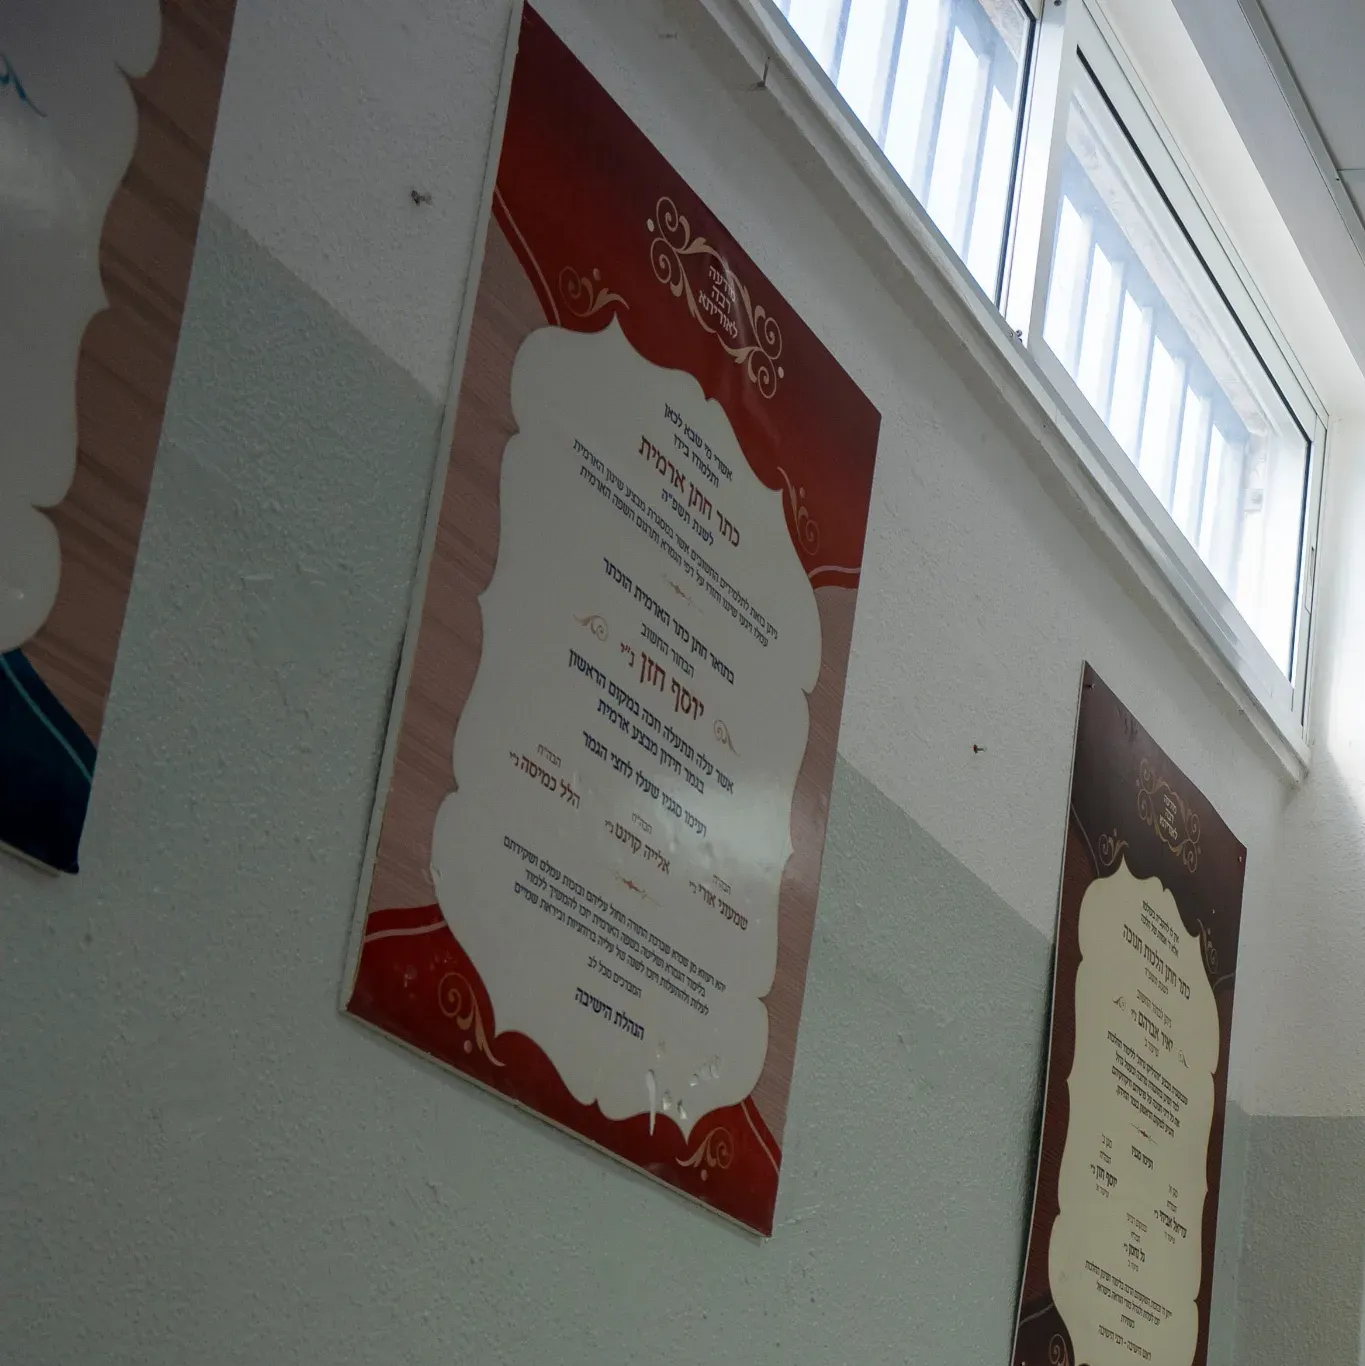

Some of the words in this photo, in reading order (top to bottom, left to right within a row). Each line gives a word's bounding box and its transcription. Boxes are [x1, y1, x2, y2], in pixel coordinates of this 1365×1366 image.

[708, 265, 737, 304] מודעה
[711, 284, 731, 314] רבה
[664, 403, 683, 428] לכאן
[673, 433, 690, 458] בידו
[683, 423, 703, 448] שבא
[638, 435, 686, 493] ארמית
[704, 442, 712, 461] מי
[691, 450, 719, 488] ותלמודו
[713, 454, 733, 482] אשרי
[661, 488, 691, 524] תשפ"ה
[687, 481, 712, 520] חתן
[691, 518, 714, 546] לשנת
[716, 509, 740, 547] כתר
[603, 557, 632, 593] הוכתר
[633, 585, 670, 627] הארמית
[640, 622, 669, 656] החשוב
[672, 618, 690, 643] כתר
[620, 642, 635, 668] נ"י
[691, 635, 708, 660] חתן
[568, 648, 606, 689] הראשון
[639, 651, 666, 692] חזן
[670, 648, 694, 678] הבחור
[709, 652, 734, 685] בתואר
[608, 680, 640, 716] במקום
[670, 677, 704, 720] יוסף
[596, 698, 630, 734] ארמית
[641, 708, 661, 734] וזכה
[582, 730, 608, 761] הגמר
[630, 725, 658, 756] מבצע
[662, 725, 694, 762] ונתעלה
[610, 752, 633, 779] לחצי
[659, 747, 682, 775] חידון
[695, 752, 714, 776] עלה
[635, 770, 660, 800] שעלו
[684, 766, 704, 795] בגמר
[715, 768, 734, 795] אשר
[661, 792, 682, 818] סגניו
[684, 810, 707, 838] ועימו
[1122, 923, 1143, 954] חנוכה
[587, 955, 598, 969] לב
[598, 960, 612, 979] מכל
[1143, 944, 1164, 974] הלכות
[612, 972, 642, 998] המברכים
[1164, 964, 1177, 987] חתן
[1178, 977, 1191, 1000] כתר
[574, 987, 613, 1020] הישיבה
[613, 1010, 645, 1040] הנהלת
